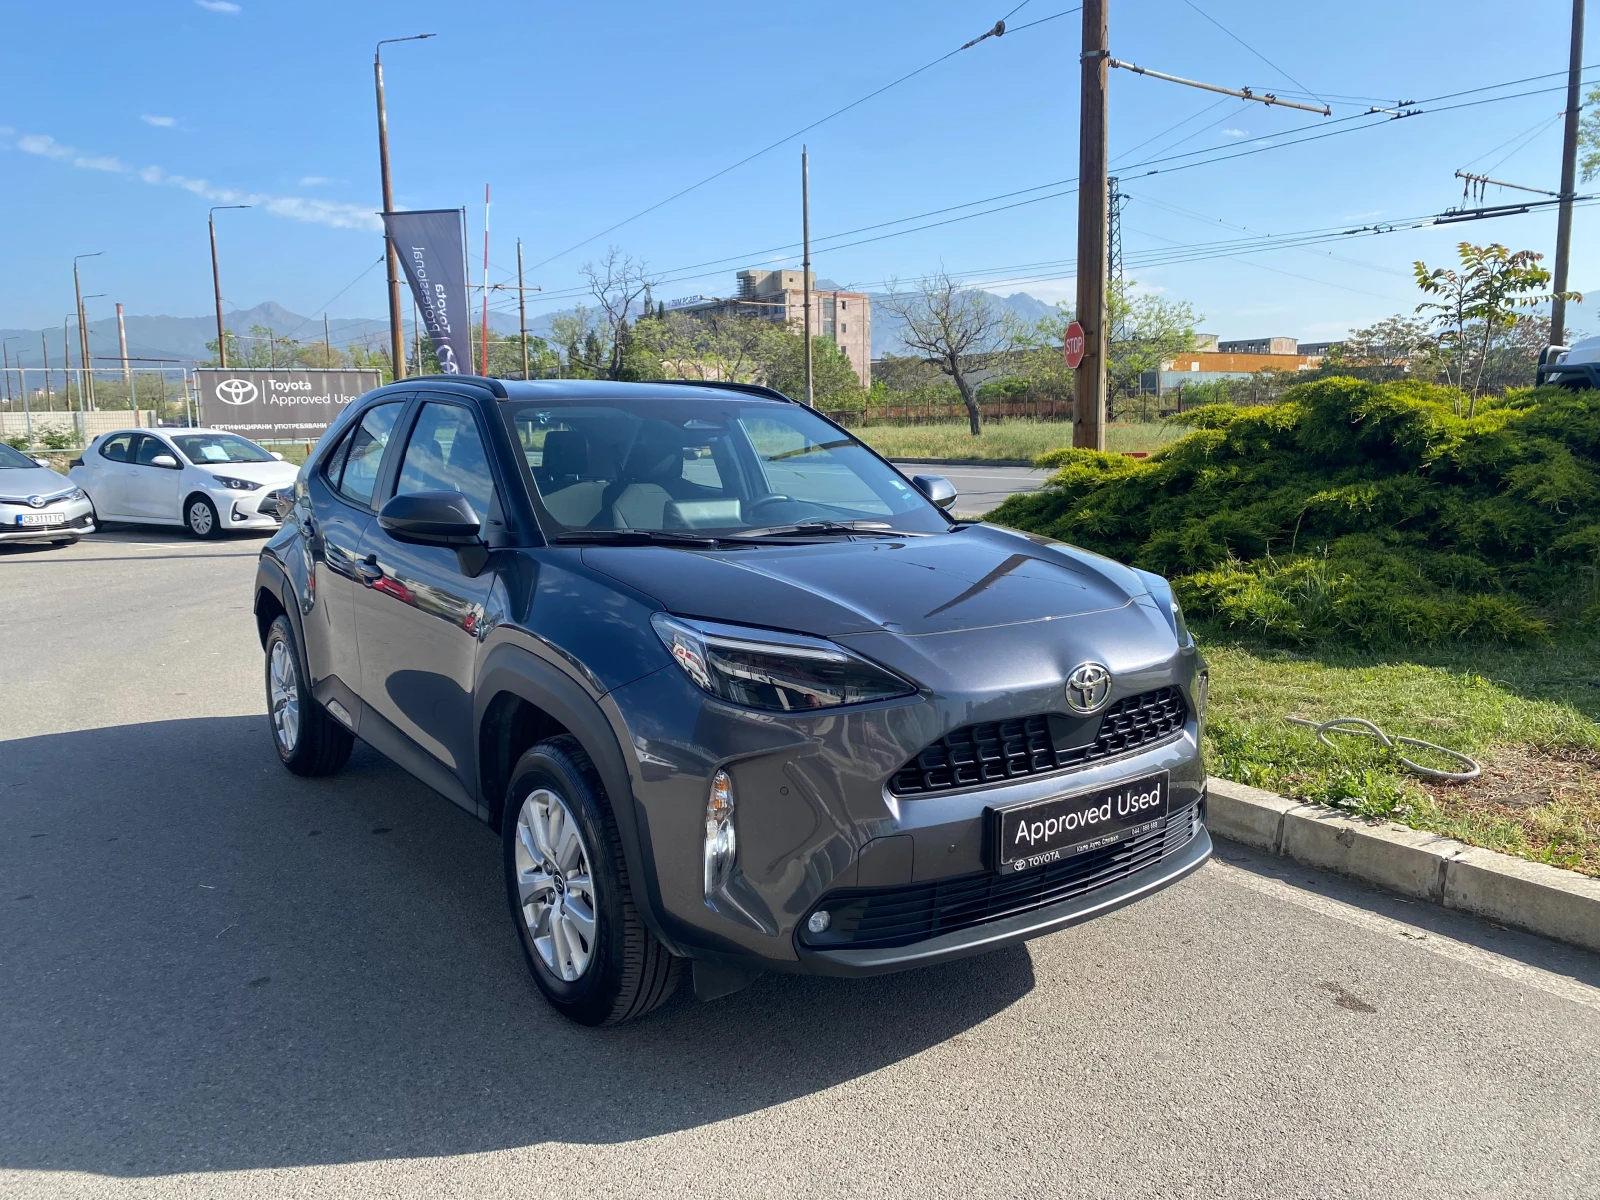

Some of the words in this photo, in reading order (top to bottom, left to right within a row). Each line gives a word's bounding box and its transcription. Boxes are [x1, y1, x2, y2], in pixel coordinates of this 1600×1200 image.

[1066, 336, 1082, 354] STOP
[268, 379, 312, 393] Toyota
[269, 393, 331, 407] Approved
[334, 393, 363, 404] Use
[210, 423, 272, 431] СЕРТИФИЦИРАНИ
[274, 422, 327, 433] УПОТРЕБЯВАНИ
[1014, 797, 1111, 846] Approved
[1117, 783, 1161, 815] Used
[1028, 850, 1061, 867] TOYOTA
